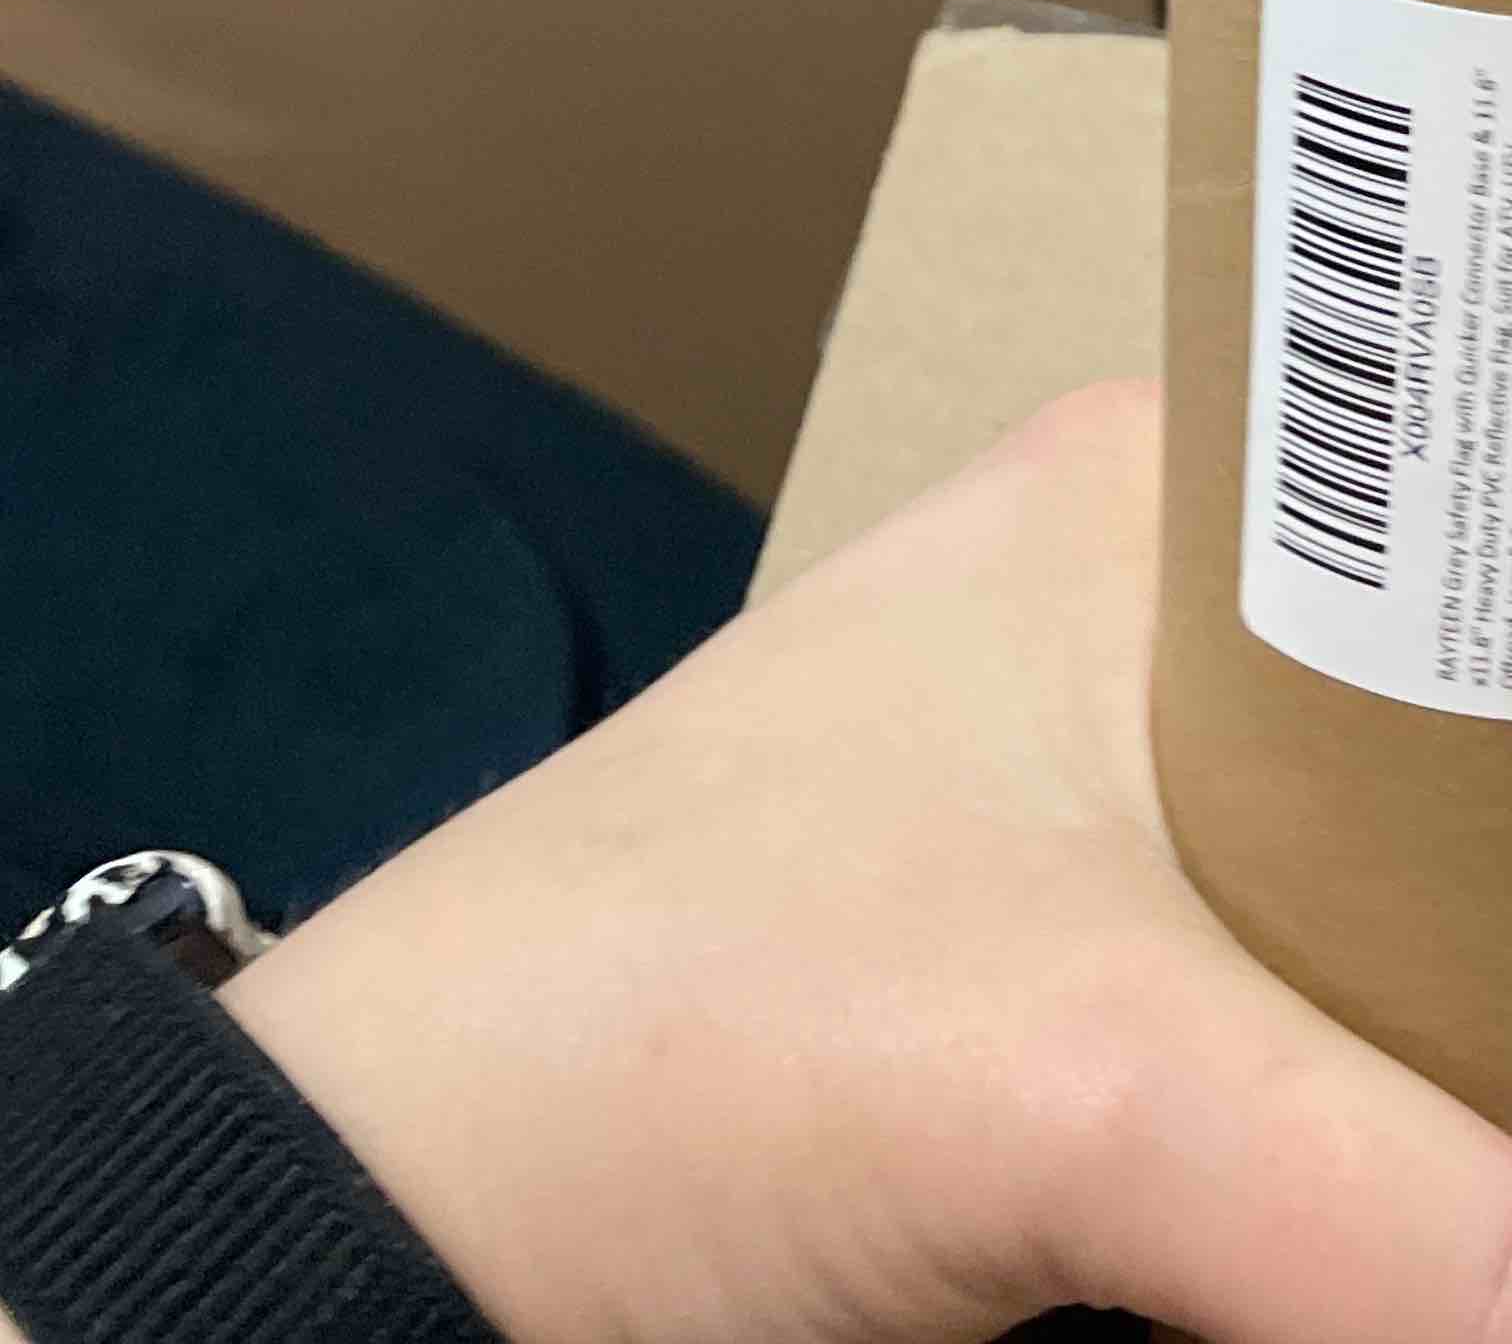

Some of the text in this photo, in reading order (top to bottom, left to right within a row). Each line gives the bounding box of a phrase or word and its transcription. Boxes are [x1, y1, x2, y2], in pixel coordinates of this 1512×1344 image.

[1465, 150, 1492, 196] Base
[1460, 201, 1490, 305] Connector
[1452, 390, 1476, 433] with
[1480, 369, 1509, 465] Reflective
[1448, 437, 1479, 475] Flag
[1443, 480, 1474, 538] Safety
[1479, 470, 1505, 507] PVC
[1475, 512, 1504, 557] Duty
[1441, 544, 1470, 590] Grey
[1472, 561, 1501, 622] Heavy
